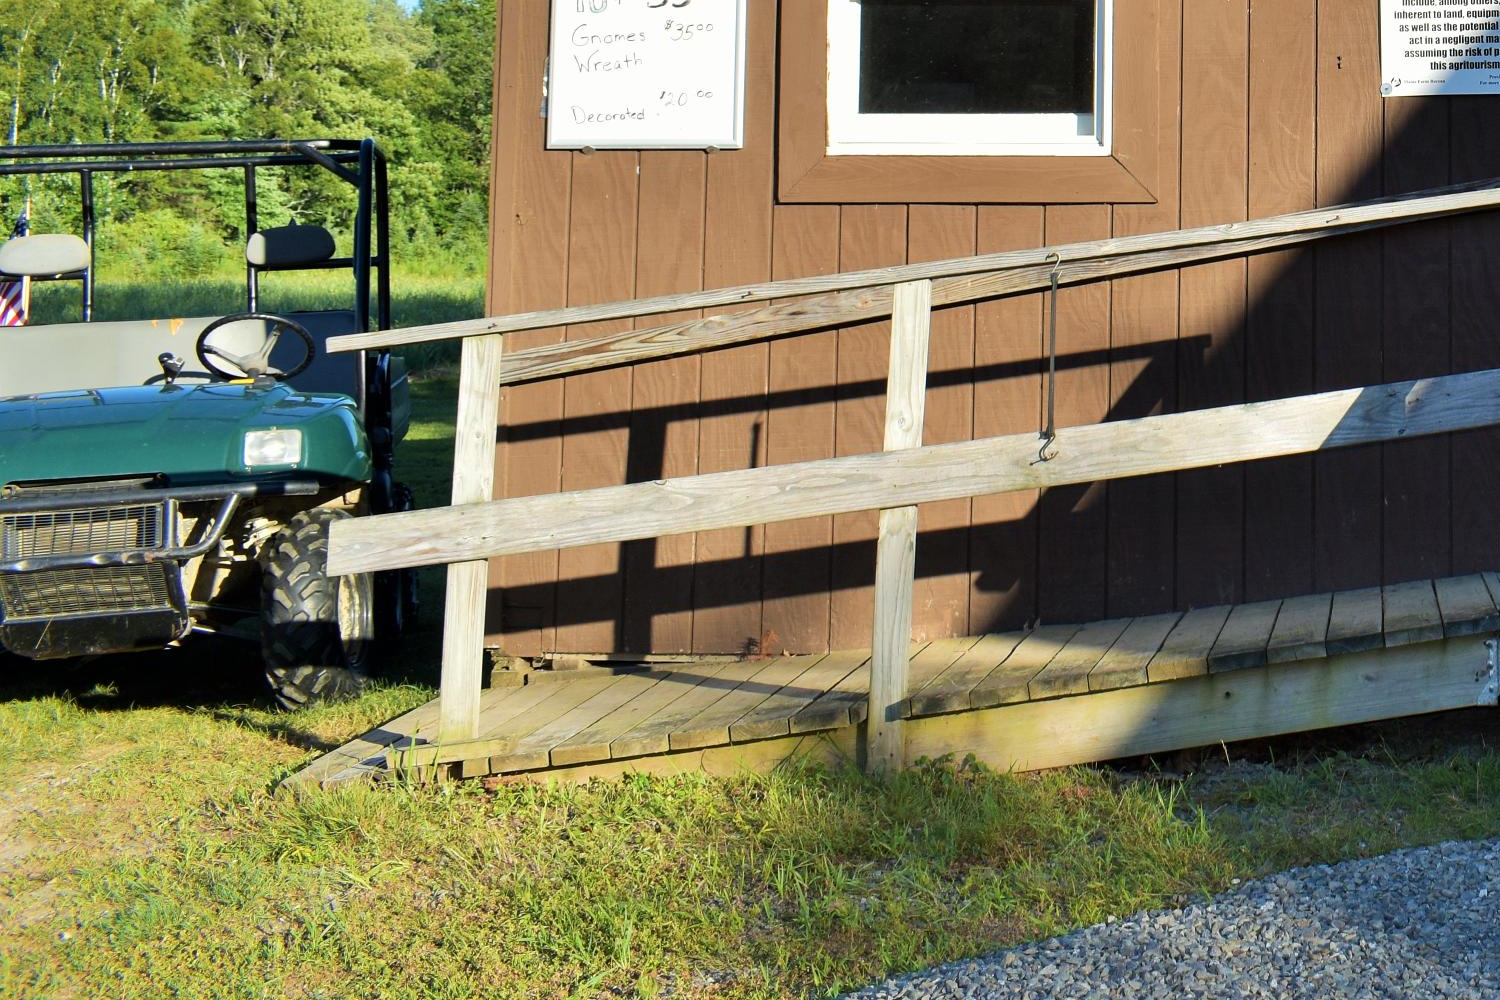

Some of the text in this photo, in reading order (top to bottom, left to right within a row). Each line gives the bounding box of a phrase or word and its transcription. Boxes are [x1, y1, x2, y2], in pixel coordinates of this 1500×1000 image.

[1394, 11, 1431, 19] inherent
[1433, 10, 1442, 18] to
[1444, 10, 1465, 19] land,
[1411, 23, 1429, 31] well
[1444, 22, 1458, 31] the
[1460, 22, 1499, 31] potential
[571, 23, 646, 47] Gnomes
[1409, 37, 1423, 45] act
[1425, 36, 1433, 44] in
[1442, 35, 1484, 45] negligent
[1404, 48, 1447, 58] assuming
[1449, 48, 1463, 57] the
[1465, 48, 1482, 56] risk
[1484, 47, 1492, 56] of
[573, 49, 643, 73] Wreath
[1430, 61, 1447, 70] this
[1449, 61, 1500, 71] agritourism
[571, 105, 645, 124] Decorated
